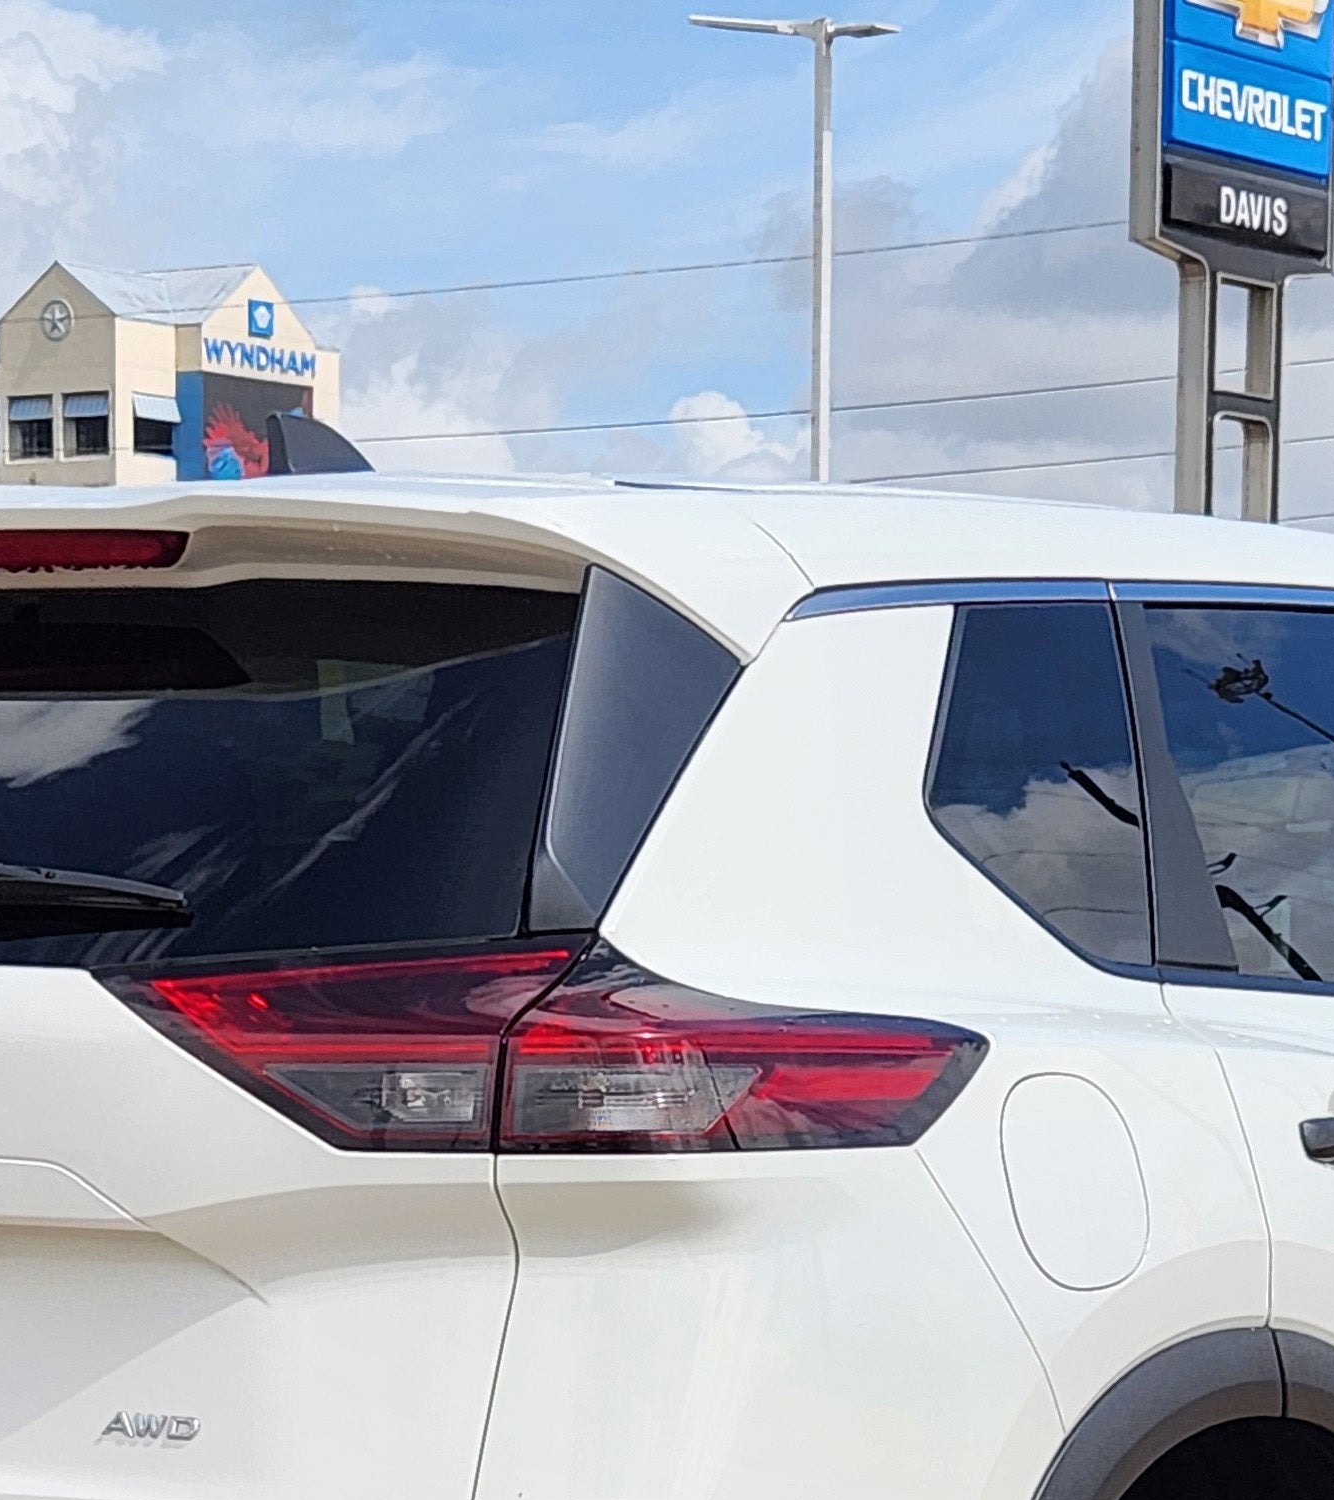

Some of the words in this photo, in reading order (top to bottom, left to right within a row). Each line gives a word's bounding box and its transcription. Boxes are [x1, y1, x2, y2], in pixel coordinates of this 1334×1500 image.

[1181, 69, 1327, 142] CHEVROLET
[1219, 185, 1287, 236] DAVIS
[204, 337, 316, 379] WYNDHAM
[101, 1411, 201, 1441] AWD
